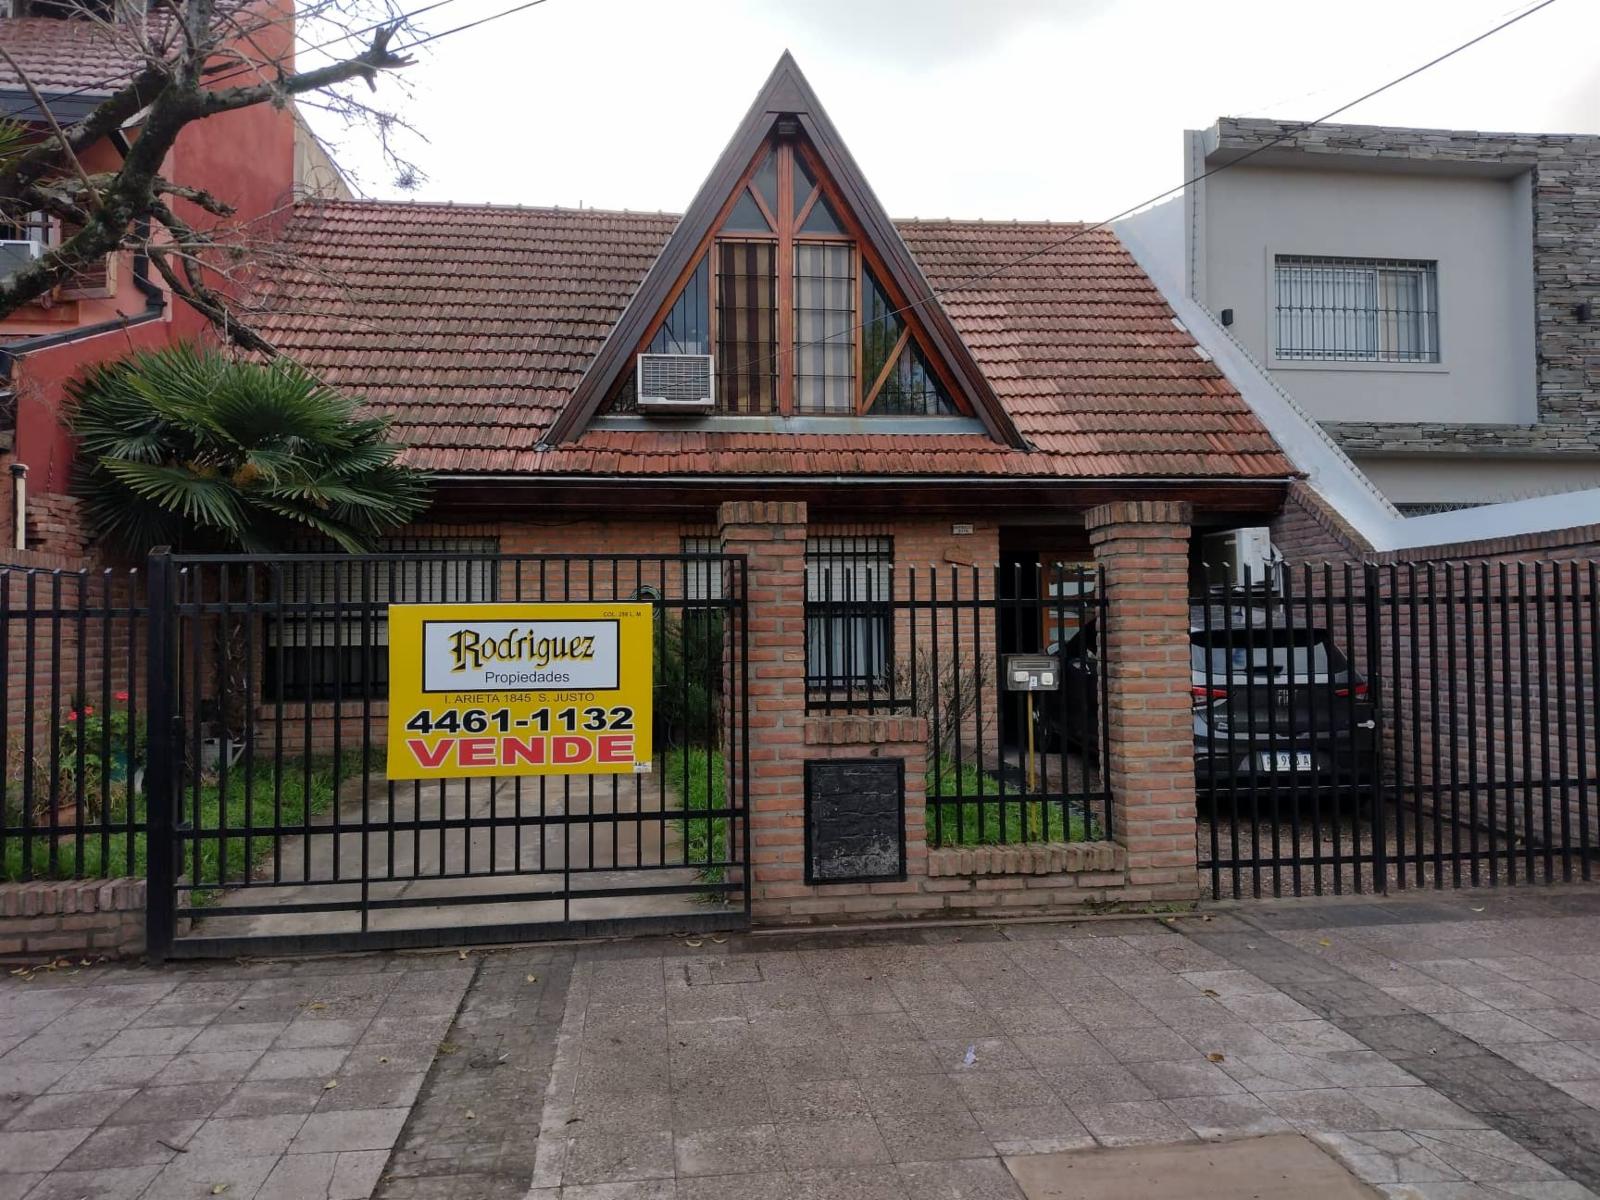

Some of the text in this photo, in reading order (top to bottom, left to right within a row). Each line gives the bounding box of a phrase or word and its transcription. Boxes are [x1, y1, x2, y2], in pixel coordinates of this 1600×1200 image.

[449, 628, 596, 671] Rodriguez
[485, 671, 570, 685] Propiedades
[454, 694, 500, 704] ARIETA
[503, 693, 532, 703] 1845
[538, 693, 550, 702] S.
[554, 692, 595, 702] JUSTO
[406, 707, 634, 734] 4461-1132
[407, 735, 635, 768] VENDE
